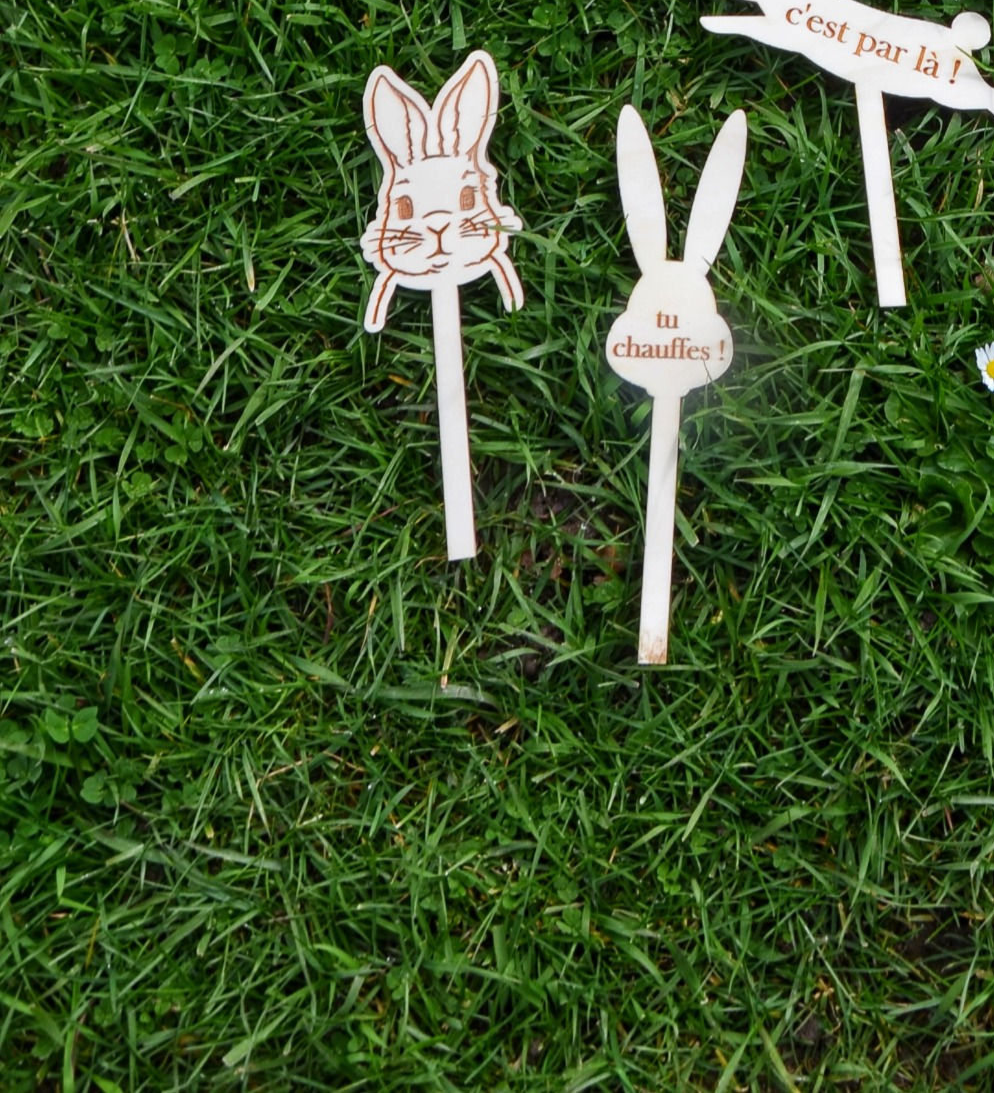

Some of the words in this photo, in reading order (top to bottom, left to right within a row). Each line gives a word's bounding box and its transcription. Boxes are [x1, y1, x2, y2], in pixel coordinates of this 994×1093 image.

[785, 3, 851, 44] c'est
[853, 31, 908, 65] par
[913, 45, 940, 79] là
[948, 59, 962, 85] !
[655, 310, 680, 329] tu
[612, 335, 711, 361] chauffes
[718, 339, 725, 361] !
